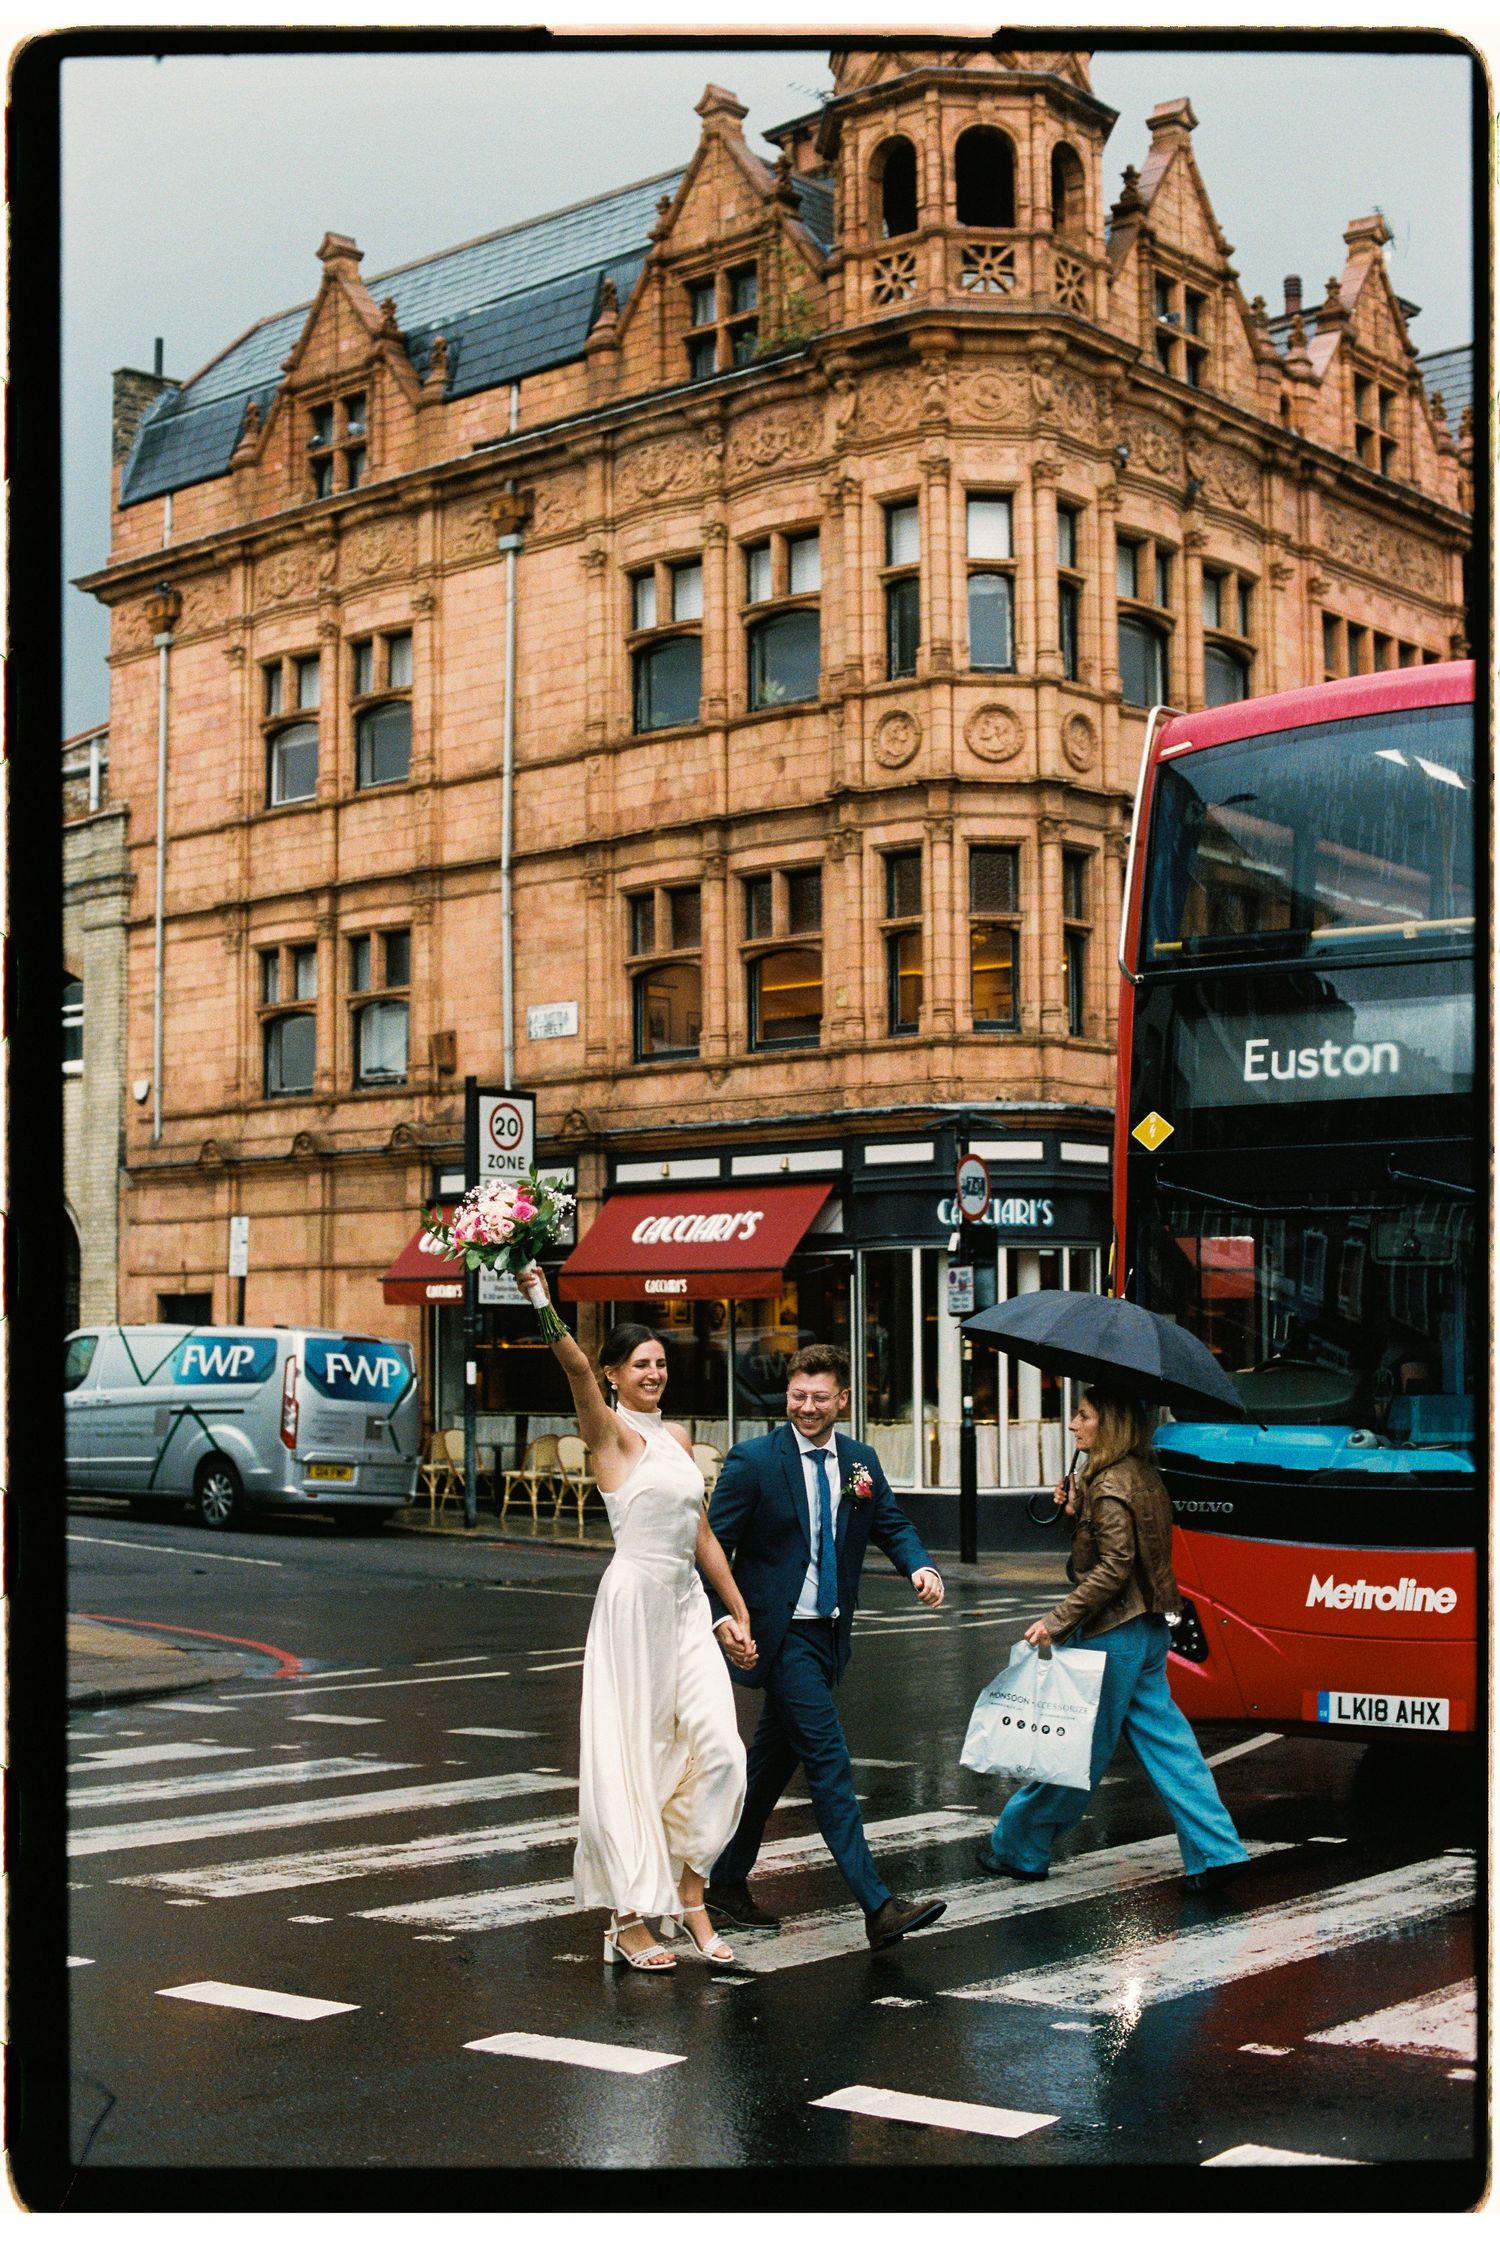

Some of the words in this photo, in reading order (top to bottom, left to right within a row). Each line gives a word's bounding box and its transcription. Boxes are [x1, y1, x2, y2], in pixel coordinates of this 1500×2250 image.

[1244, 1038, 1399, 1082] Euston
[495, 1117, 518, 1137] 20
[488, 1154, 525, 1170] ZONE
[937, 1198, 1054, 1226] CACIARI'S
[631, 1210, 765, 1244] CACCIARI'S
[644, 1279, 688, 1294] CACCIARI'S
[181, 1345, 255, 1377] FWP
[325, 1353, 401, 1388] FWP
[1172, 1500, 1234, 1514] VOLVO
[1305, 1574, 1458, 1614] Metroline
[989, 1690, 1031, 1705] MONSOON
[1337, 1696, 1388, 1722] LK18
[1396, 1700, 1440, 1726] AHX
